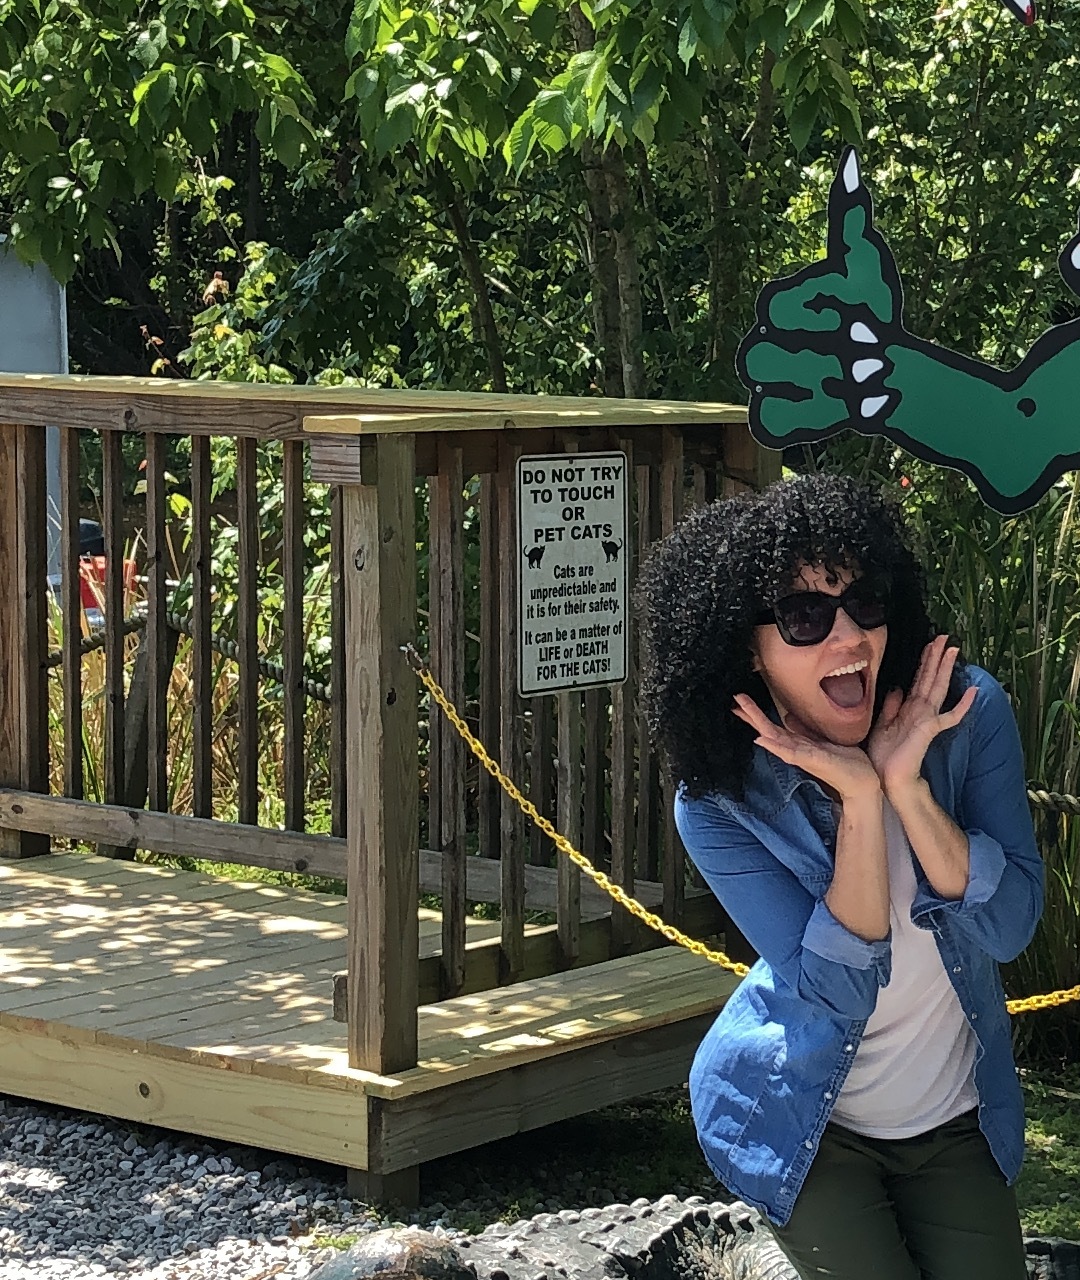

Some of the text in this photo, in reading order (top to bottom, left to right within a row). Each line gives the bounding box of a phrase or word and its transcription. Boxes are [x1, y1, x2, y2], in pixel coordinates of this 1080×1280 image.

[522, 466, 623, 485] DO NOT TRY
[530, 485, 615, 504] TO TOUCH
[562, 507, 585, 521] OR
[534, 524, 613, 543] PET CATS
[554, 564, 594, 579] Cats are
[530, 578, 617, 602] unpredictable and
[527, 597, 620, 619] it is for their safety.
[525, 621, 623, 645] It can be a matter of
[539, 640, 609, 662] LIFE or DEATH
[537, 658, 611, 681] FOR THE CATS!
